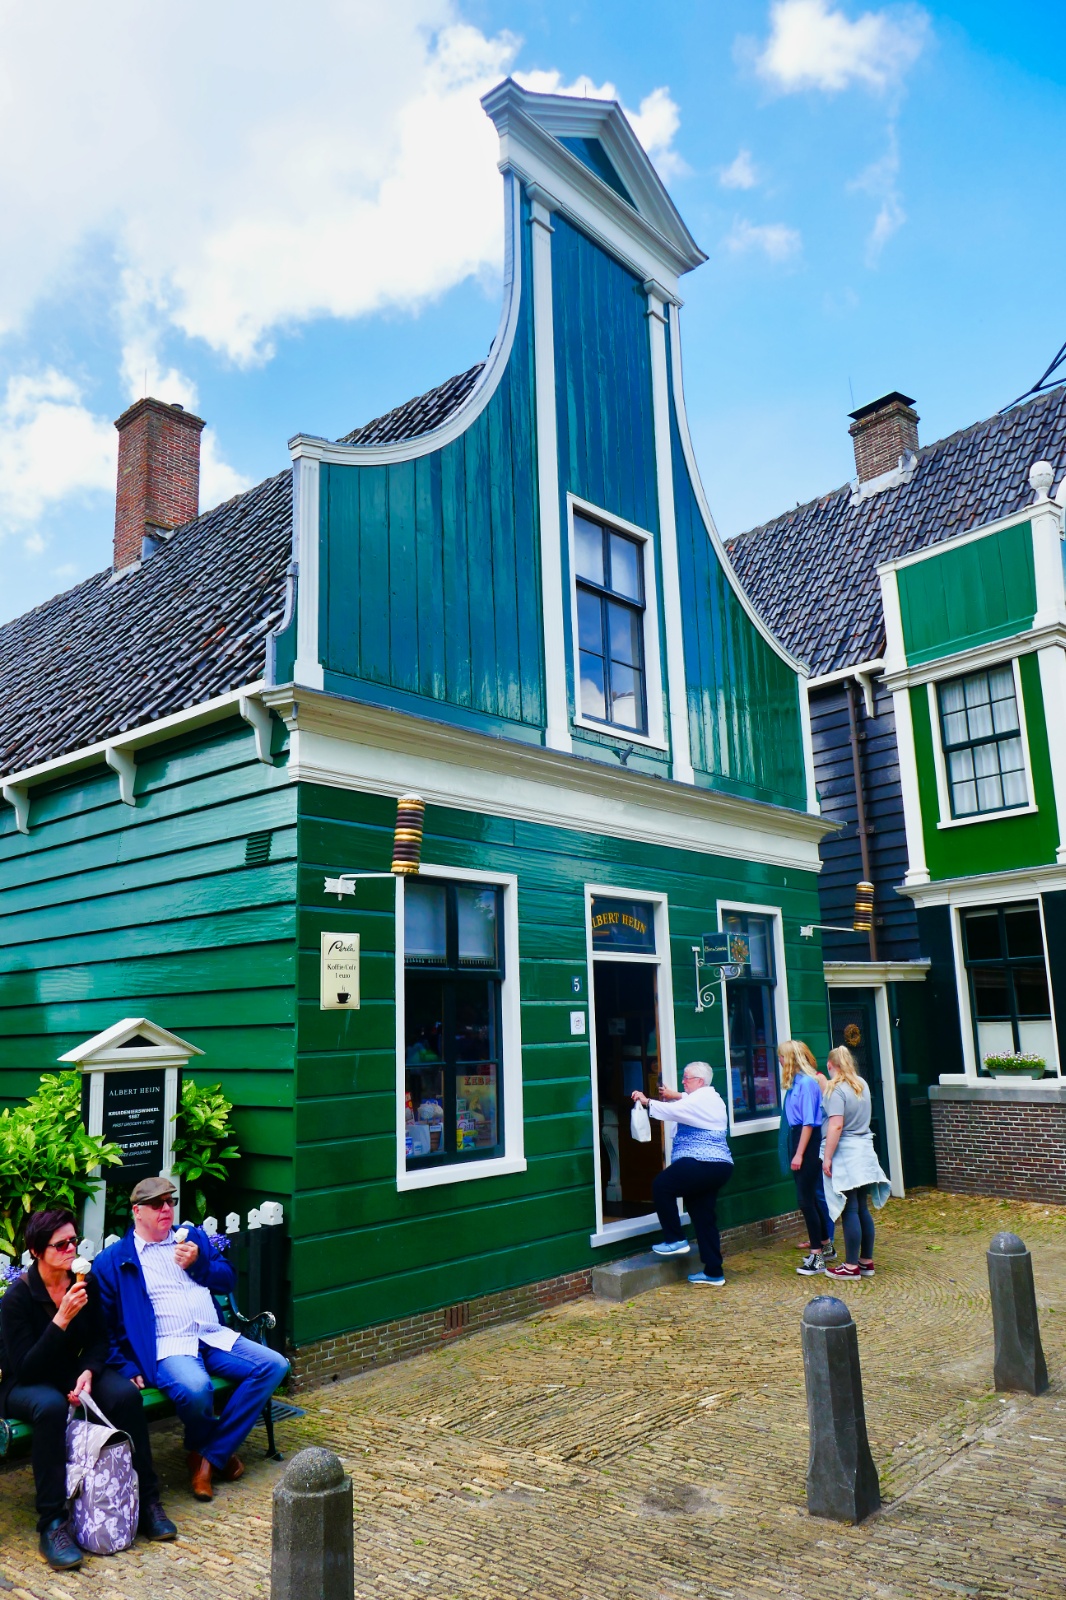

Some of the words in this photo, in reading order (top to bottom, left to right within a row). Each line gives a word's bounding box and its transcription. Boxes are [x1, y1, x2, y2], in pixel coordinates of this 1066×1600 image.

[591, 912, 619, 929] LBERT
[622, 914, 647, 934] HEIJN
[574, 977, 580, 992] 5
[895, 1018, 900, 1027] 7
[108, 1088, 137, 1096] ALBERT
[140, 1086, 160, 1094] HEIJN
